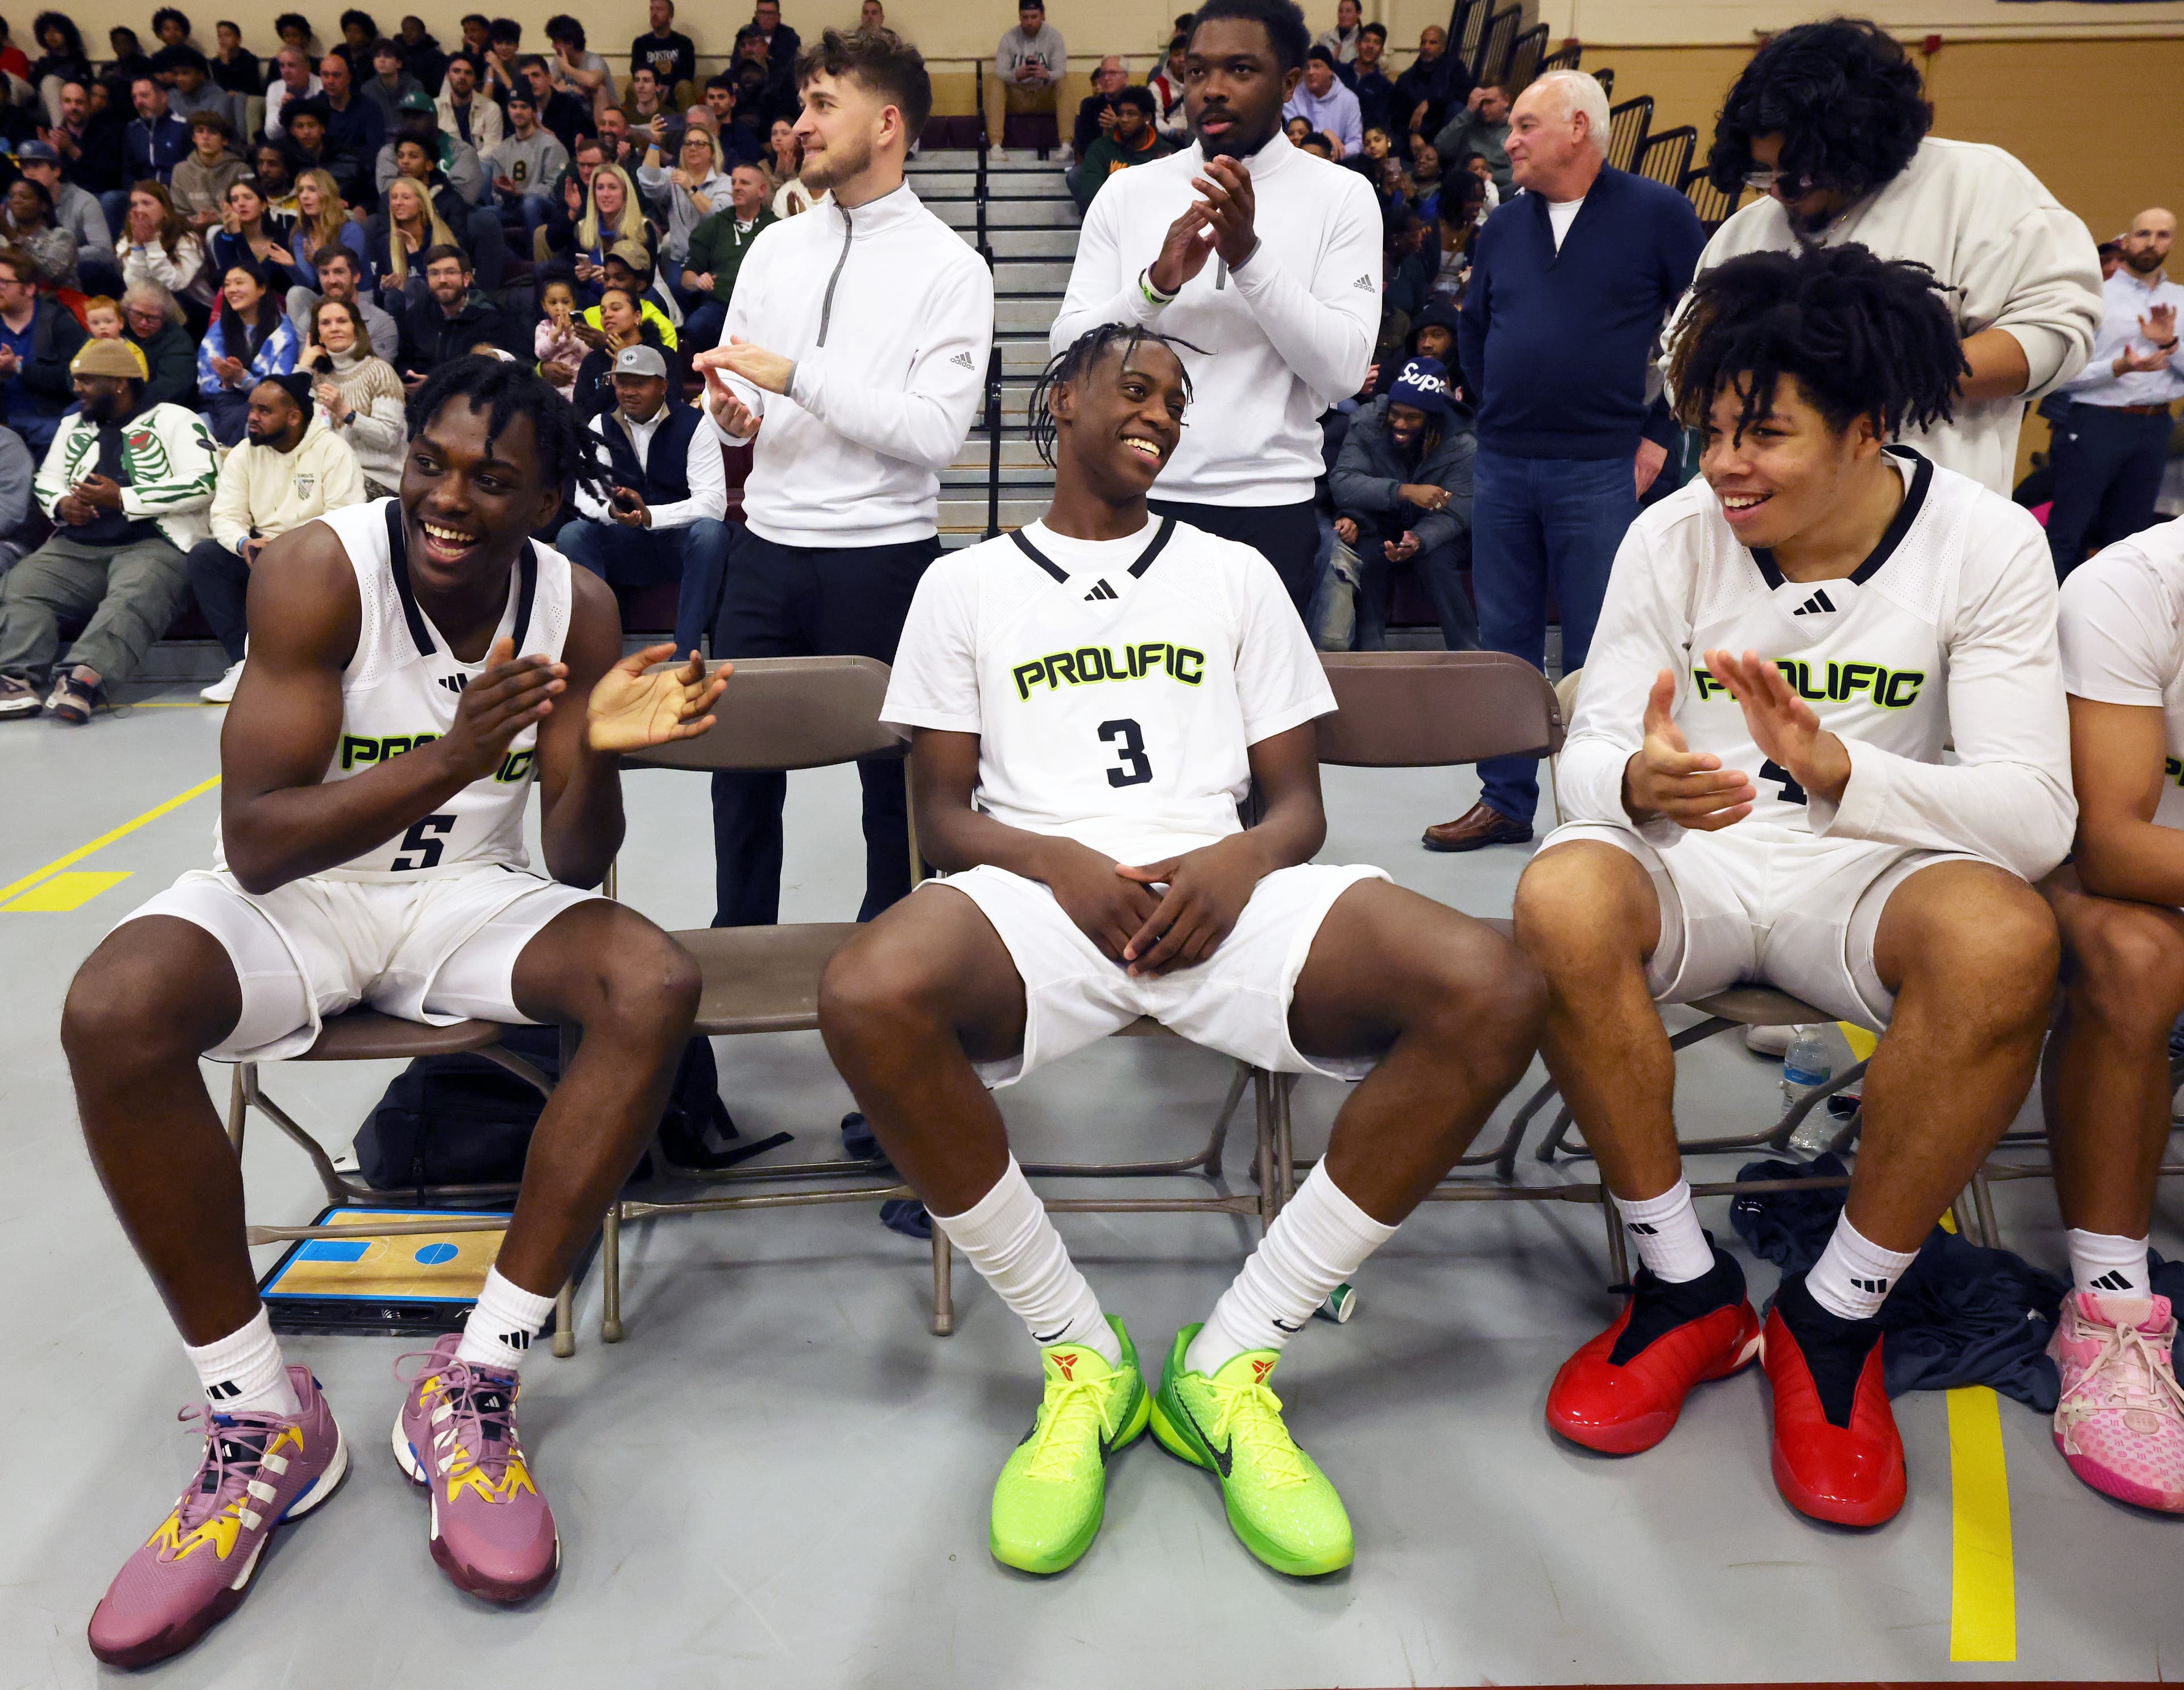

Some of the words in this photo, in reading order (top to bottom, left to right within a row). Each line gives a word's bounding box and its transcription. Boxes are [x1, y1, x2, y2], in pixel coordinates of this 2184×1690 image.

[647, 49, 679, 63] BOSTON
[1354, 282, 1375, 293] adidas
[950, 358, 975, 370] adidas
[1012, 642, 1205, 701] PROLIFIC
[1692, 659, 1926, 709] PLIFIC
[1098, 718, 1153, 788] 3
